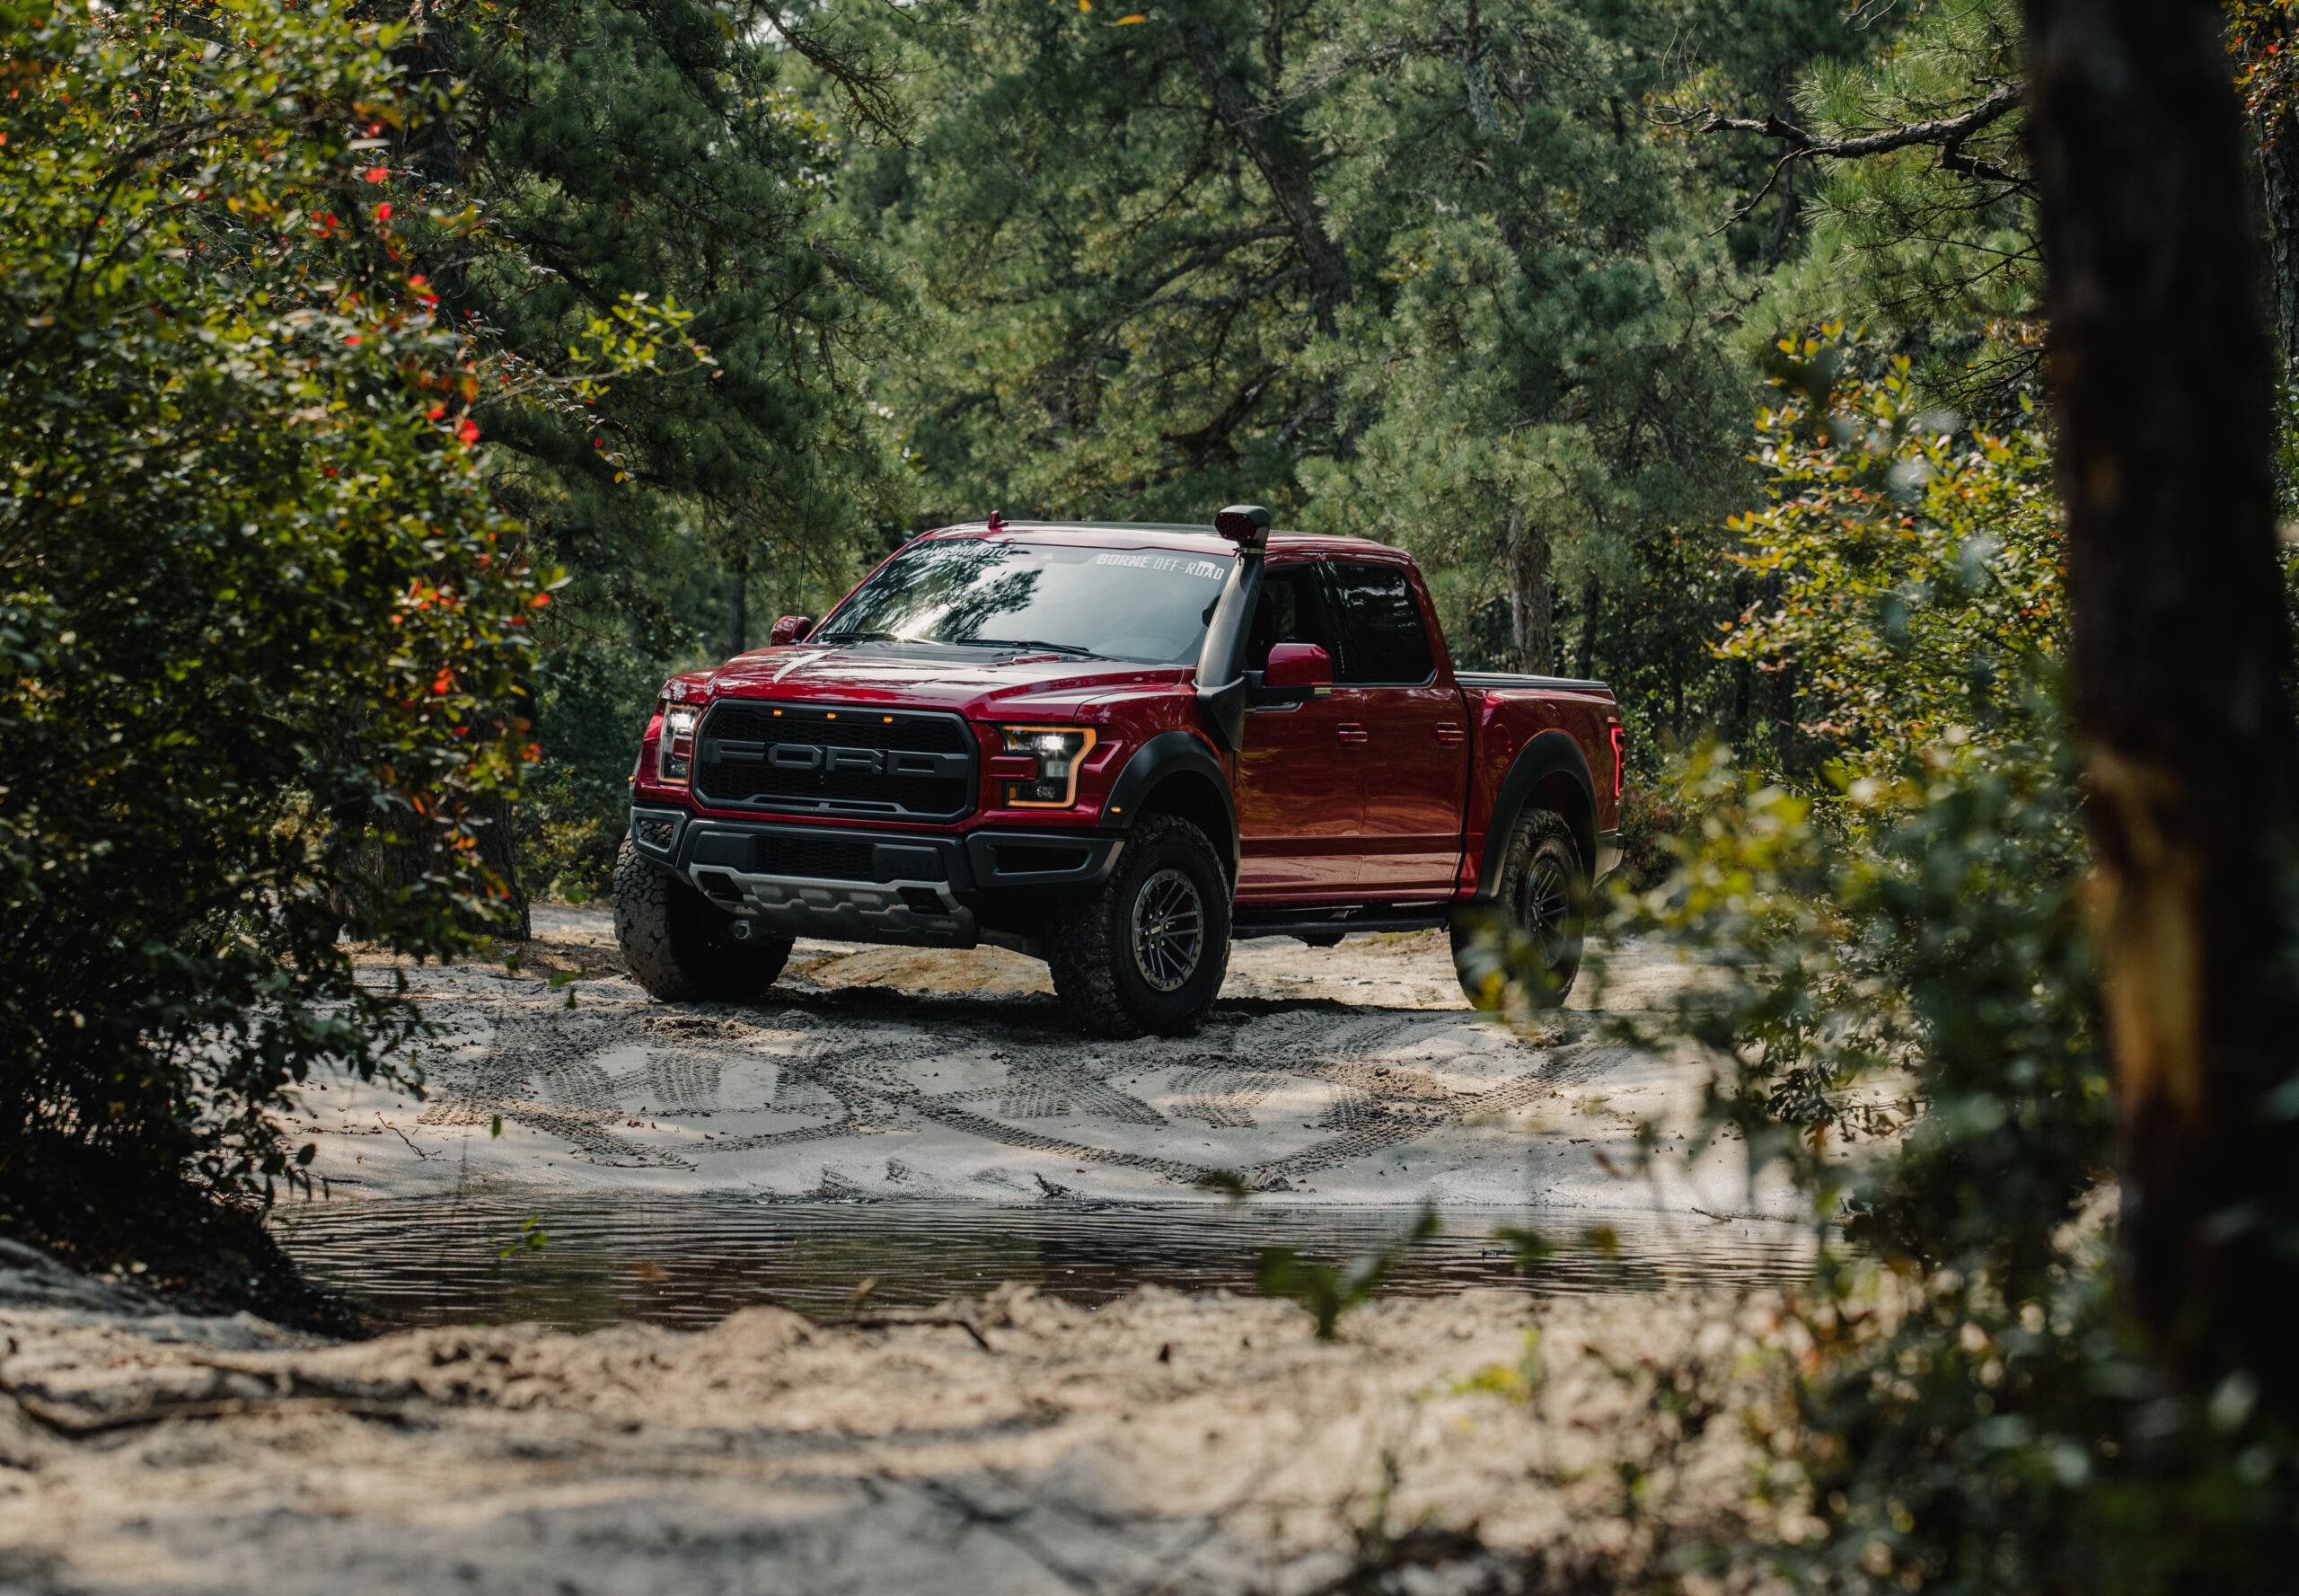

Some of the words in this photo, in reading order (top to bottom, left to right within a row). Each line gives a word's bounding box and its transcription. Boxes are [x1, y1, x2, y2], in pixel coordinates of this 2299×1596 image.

[1096, 553, 1151, 569] BORNE
[1152, 557, 1225, 580] OFF-ROAD
[708, 738, 964, 778] FORD
